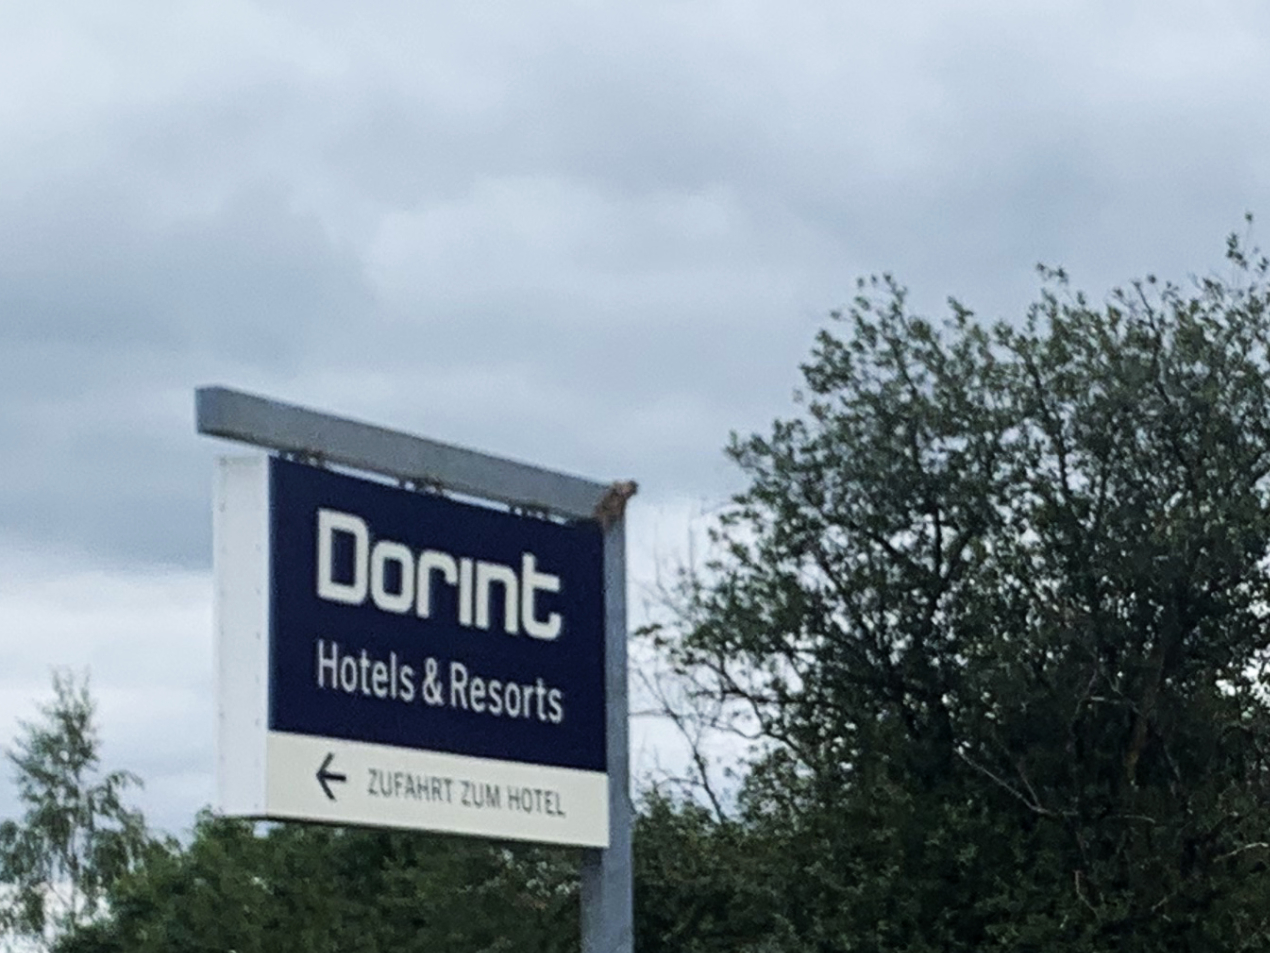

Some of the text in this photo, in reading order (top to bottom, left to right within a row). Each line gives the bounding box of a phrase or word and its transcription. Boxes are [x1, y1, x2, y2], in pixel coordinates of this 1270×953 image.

[317, 507, 563, 641] Dorint
[316, 639, 563, 723] Hotels & Resorts
[367, 767, 567, 817] ZUFAHRT ZUM HOTEL
